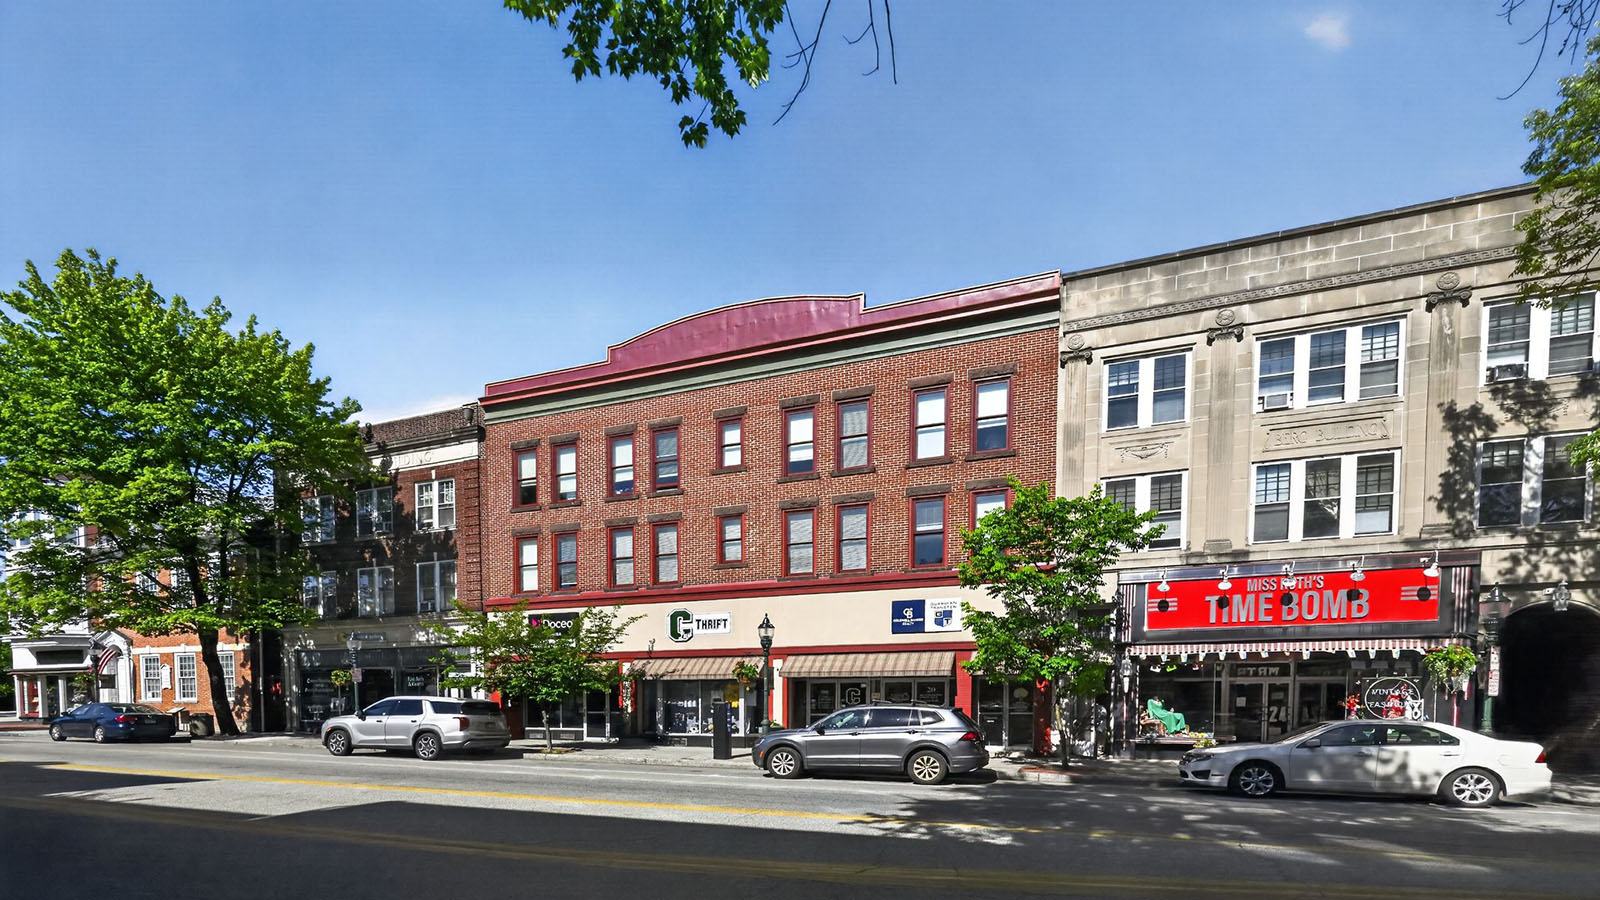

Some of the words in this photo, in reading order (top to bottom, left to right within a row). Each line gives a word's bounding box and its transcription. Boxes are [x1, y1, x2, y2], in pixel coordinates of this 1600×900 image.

[1247, 578, 1277, 592] MISS
[1205, 592, 1273, 624] TIME
[1282, 588, 1369, 621] BOMB
[543, 619, 573, 629] Doceo
[695, 618, 728, 630] THRIFT
